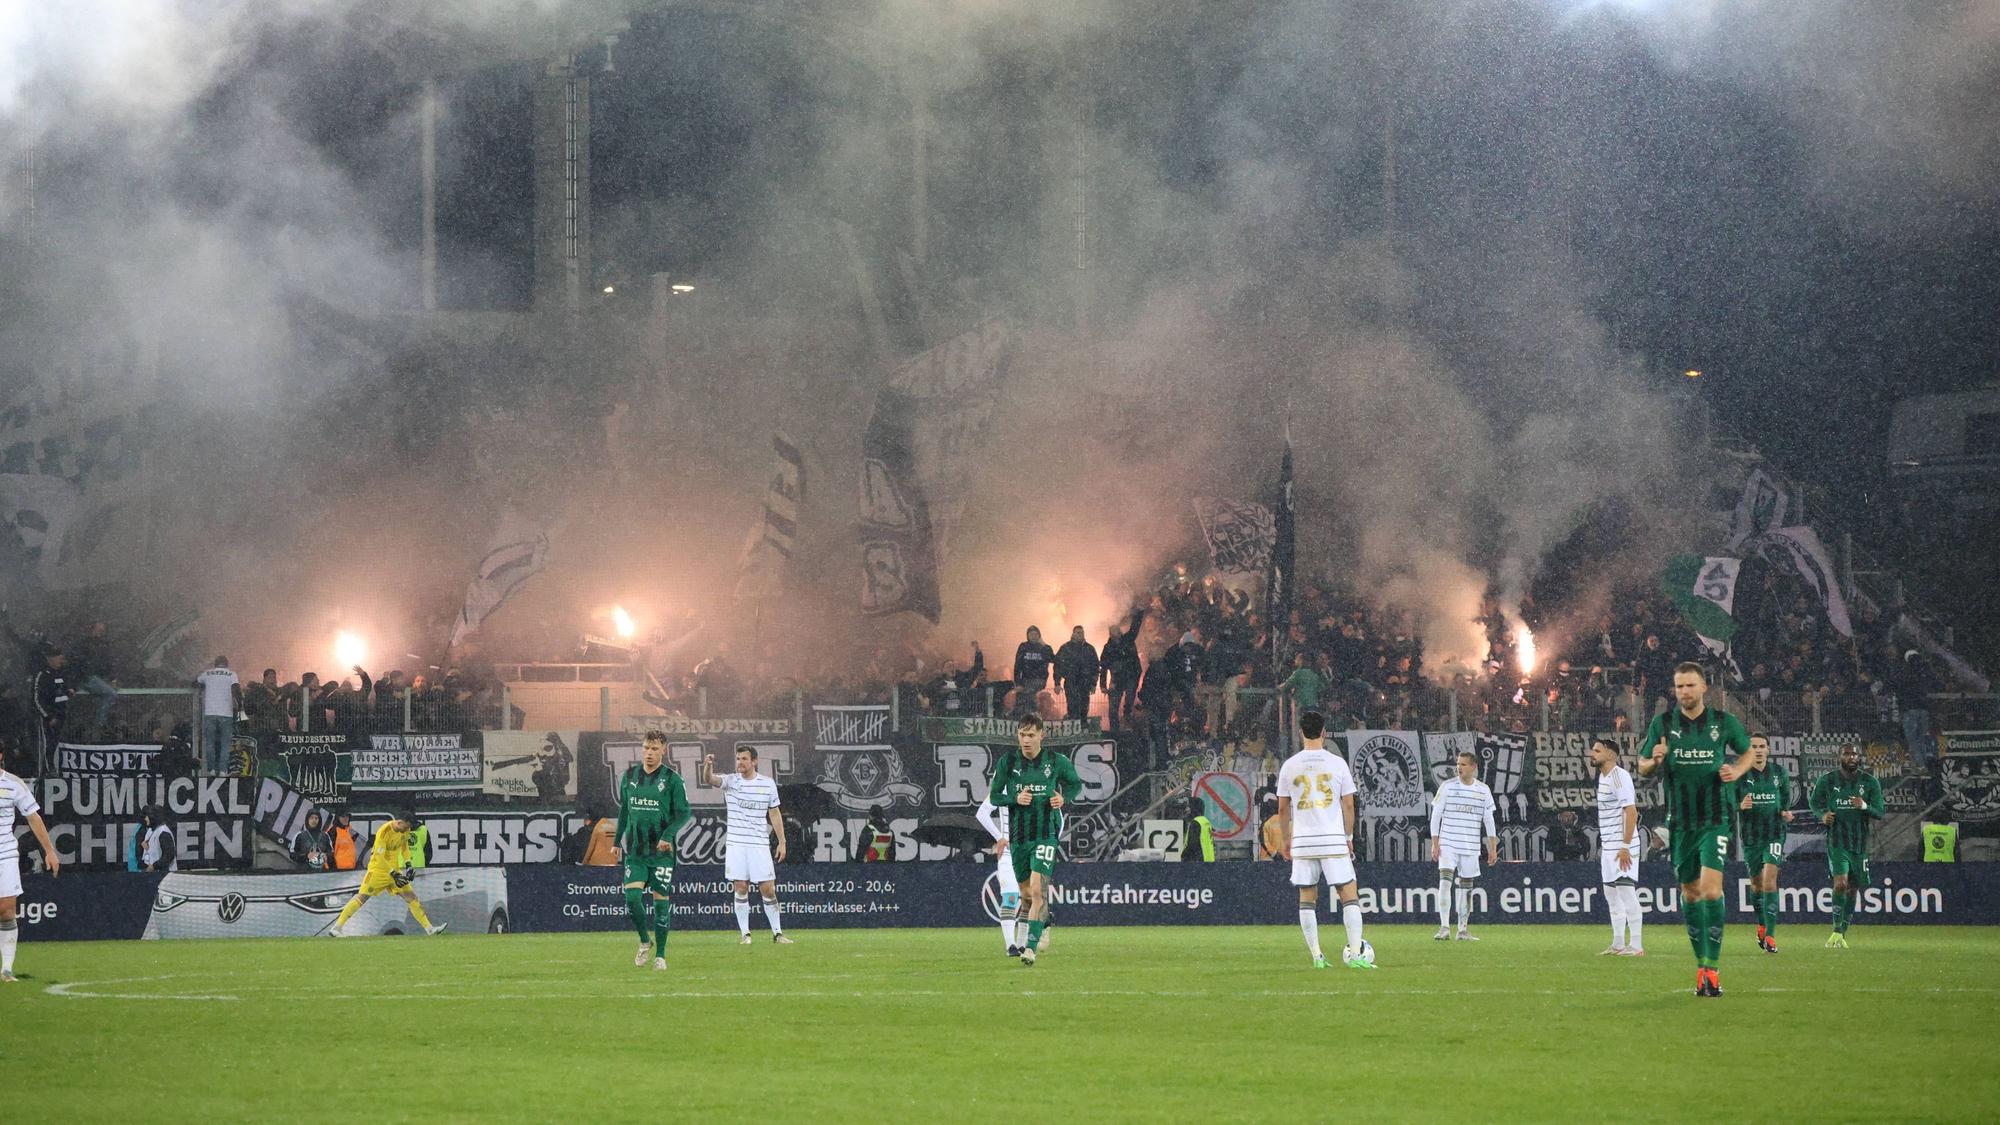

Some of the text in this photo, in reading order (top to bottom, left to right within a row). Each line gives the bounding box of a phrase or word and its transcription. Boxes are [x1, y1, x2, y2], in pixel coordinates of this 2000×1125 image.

[279, 735, 346, 743] REUNDESKREIS
[371, 736, 460, 750] WIR WOLLEN
[61, 751, 160, 770] RISPET
[352, 751, 409, 765] LIEBER
[1674, 749, 1714, 758] flatex
[352, 766, 479, 781] ALS DISKUTIEREN
[1293, 774, 1332, 810] 25
[630, 797, 659, 806] flatex
[1149, 830, 1179, 852] C2
[1717, 836, 1729, 855] 5
[1770, 842, 1781, 855] 10
[1036, 844, 1054, 861] 20
[655, 866, 673, 883] 25
[679, 882, 734, 893] kWh/100
[777, 882, 825, 892] mbiniert
[828, 881, 854, 894] 22,0
[866, 881, 896, 894] 20,6;
[1500, 877, 1597, 912] einer
[1048, 883, 1213, 909] Nutzfahrzeuge
[779, 902, 866, 914] Effizienzklasse:
[869, 902, 900, 913] A+++
